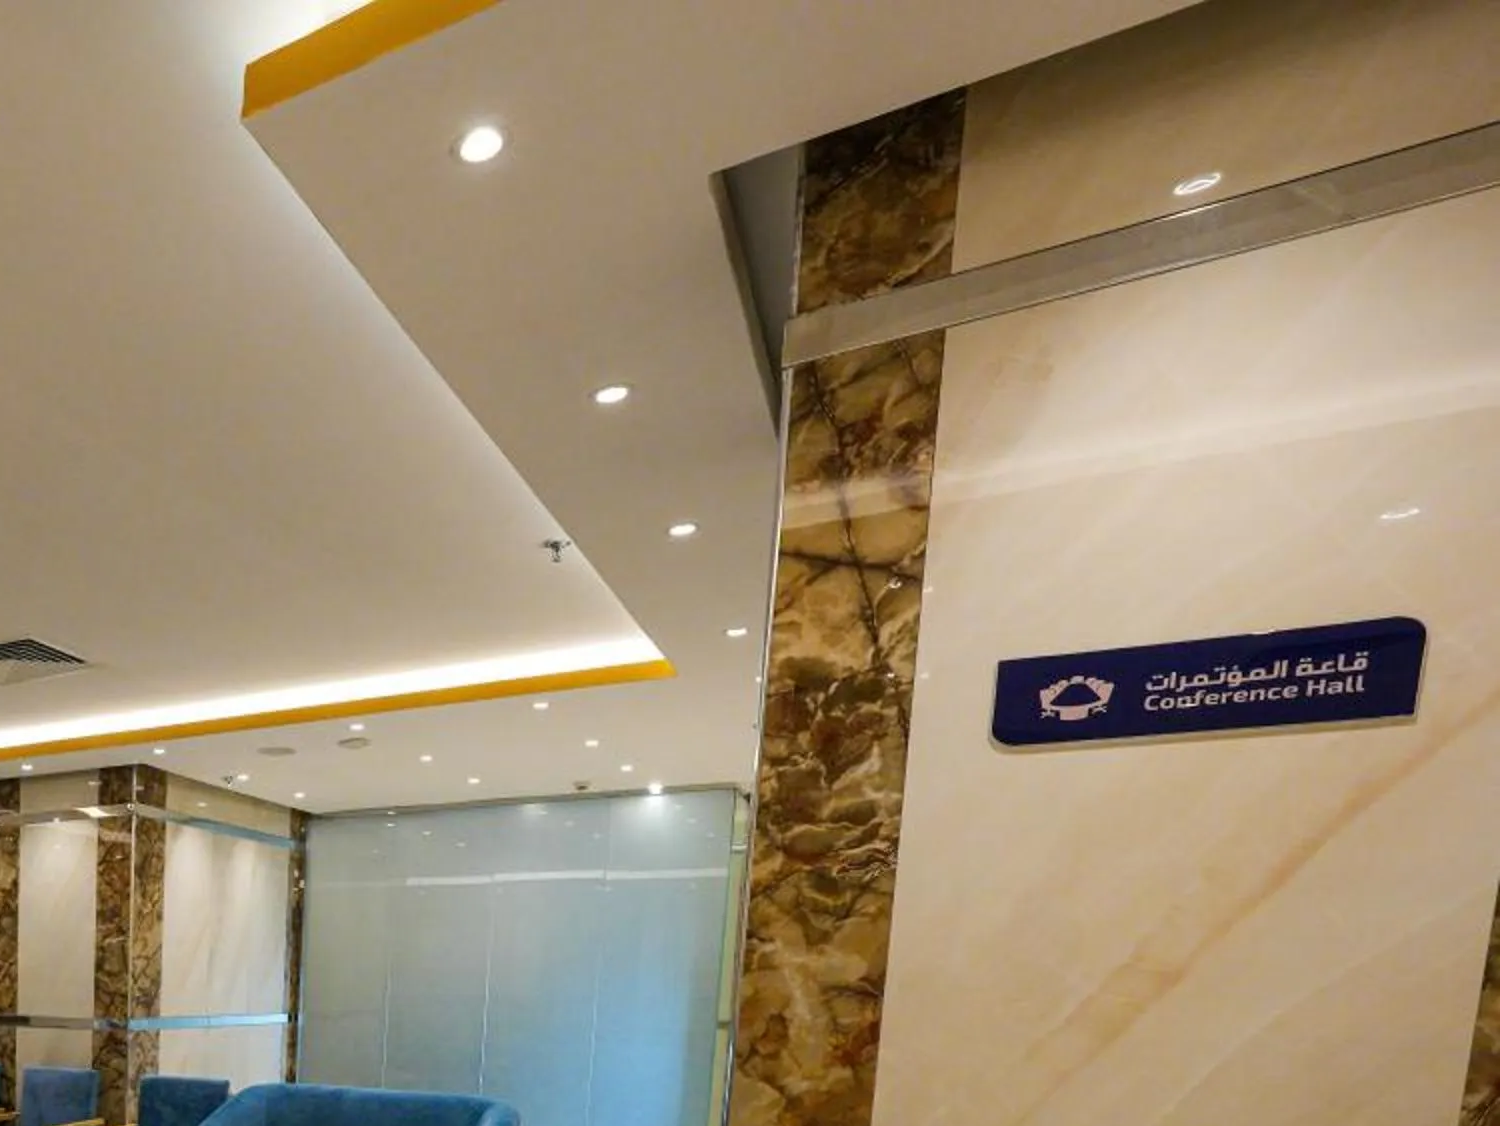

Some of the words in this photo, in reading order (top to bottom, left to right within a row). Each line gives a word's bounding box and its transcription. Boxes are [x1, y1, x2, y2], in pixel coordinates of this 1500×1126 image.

[1145, 659, 1289, 693] المؤتمرات
[1295, 651, 1369, 677] قاعة
[1143, 684, 1299, 711] Conference
[1305, 674, 1365, 697] Hall
